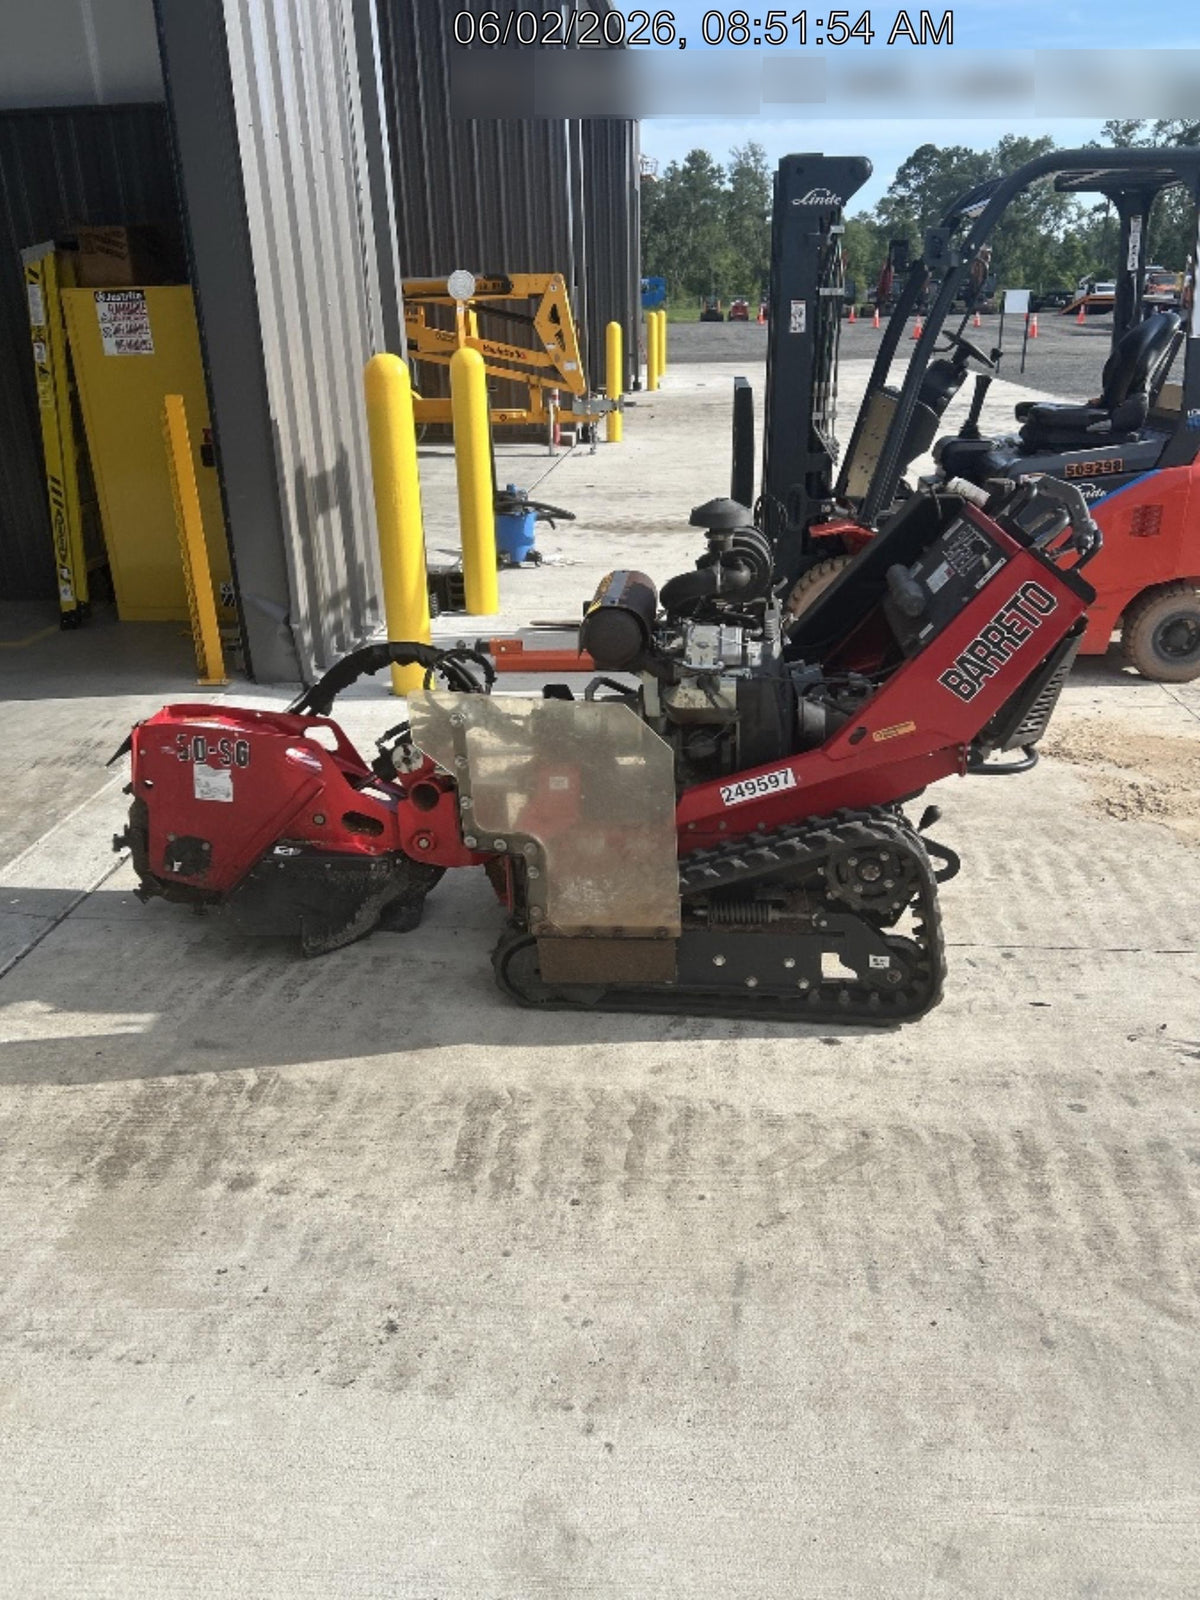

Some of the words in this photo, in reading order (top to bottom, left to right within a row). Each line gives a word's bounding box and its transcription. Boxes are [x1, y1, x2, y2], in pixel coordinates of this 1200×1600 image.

[792, 187, 842, 206] Linde
[937, 580, 1059, 704] BARRETO
[720, 769, 792, 804] 249597
